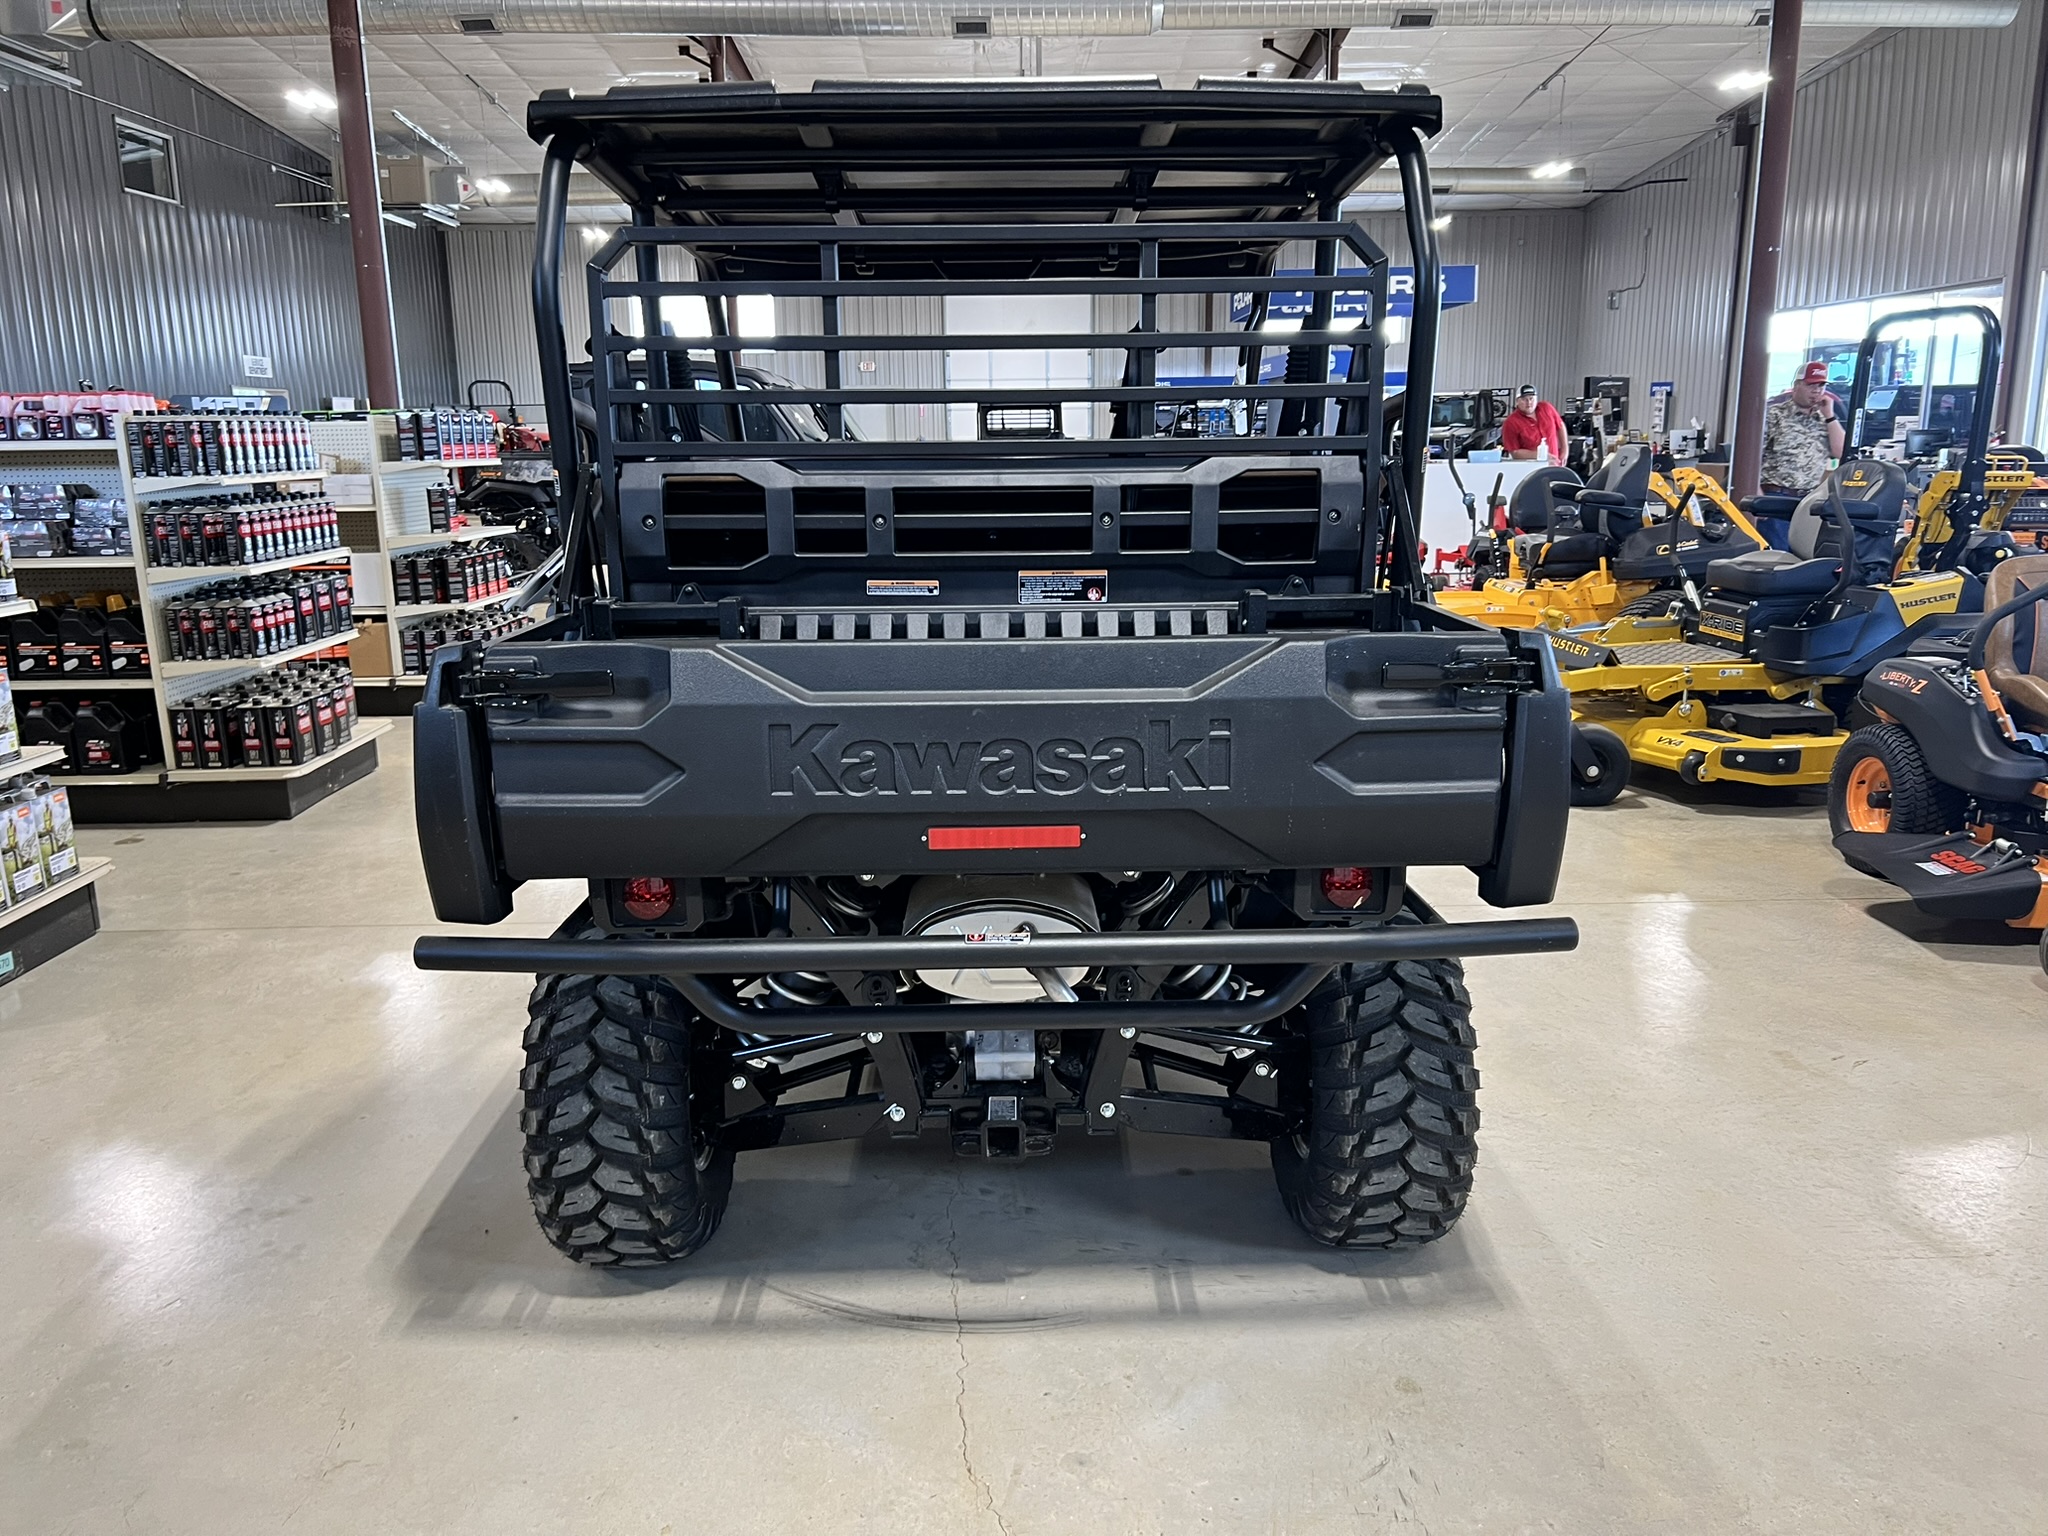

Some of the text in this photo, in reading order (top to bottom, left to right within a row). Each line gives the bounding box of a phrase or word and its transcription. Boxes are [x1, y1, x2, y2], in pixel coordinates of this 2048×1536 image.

[1900, 592, 1957, 609] HUSTLER
[767, 718, 1232, 797] Kawasaki
[1930, 850, 1986, 874] SCAG
